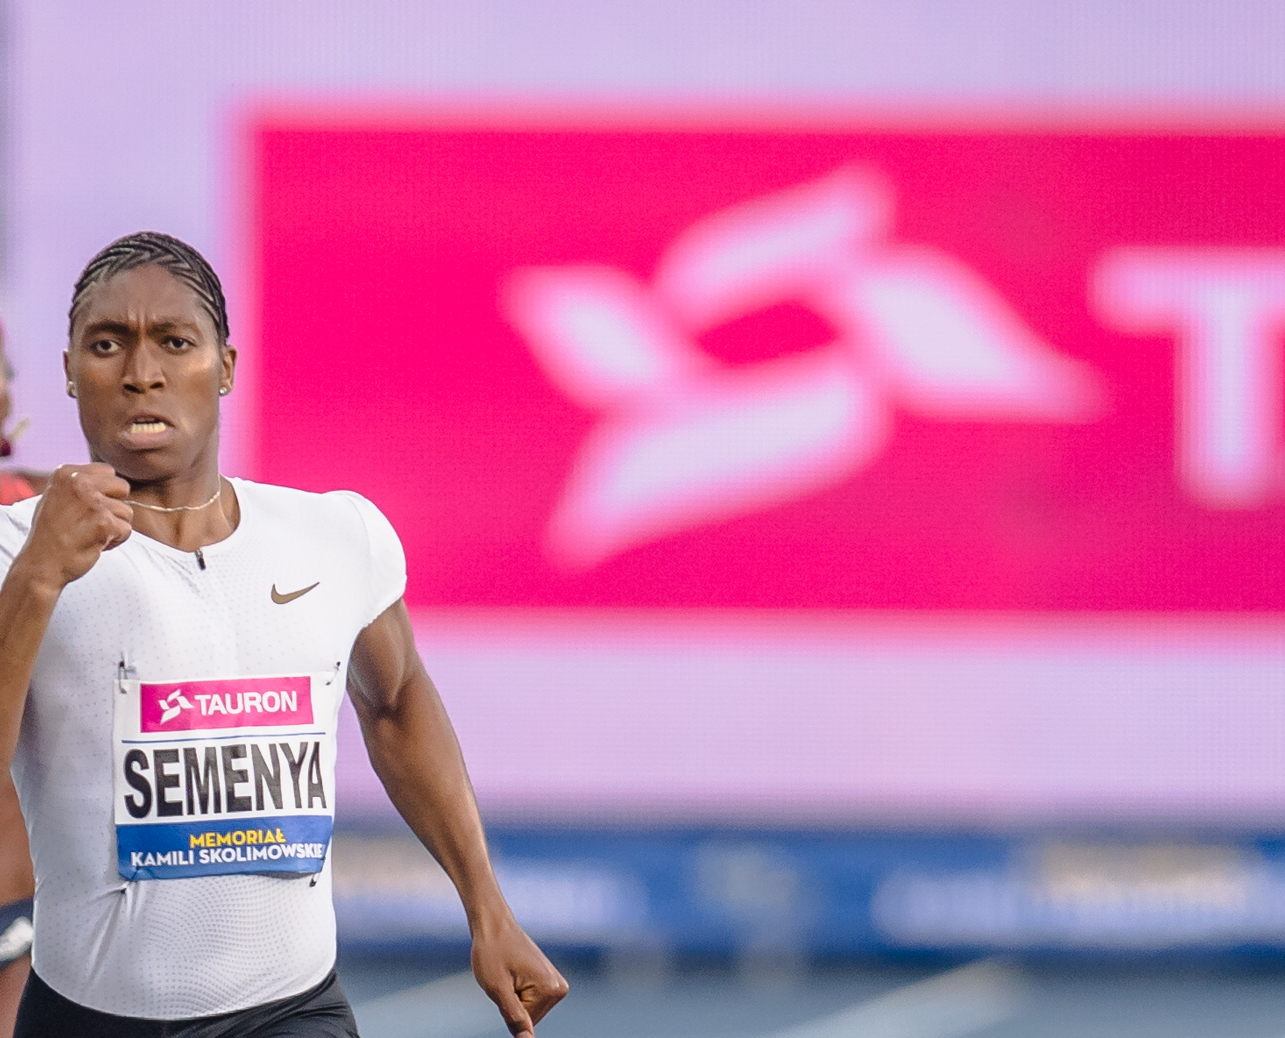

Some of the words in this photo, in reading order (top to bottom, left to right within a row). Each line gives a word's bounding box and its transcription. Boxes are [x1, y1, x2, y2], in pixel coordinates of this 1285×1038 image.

[194, 690, 298, 717] TAURON
[123, 741, 328, 819] SEMENYA
[189, 828, 287, 849] MEMORIAŁ
[130, 851, 195, 867] KAMILI
